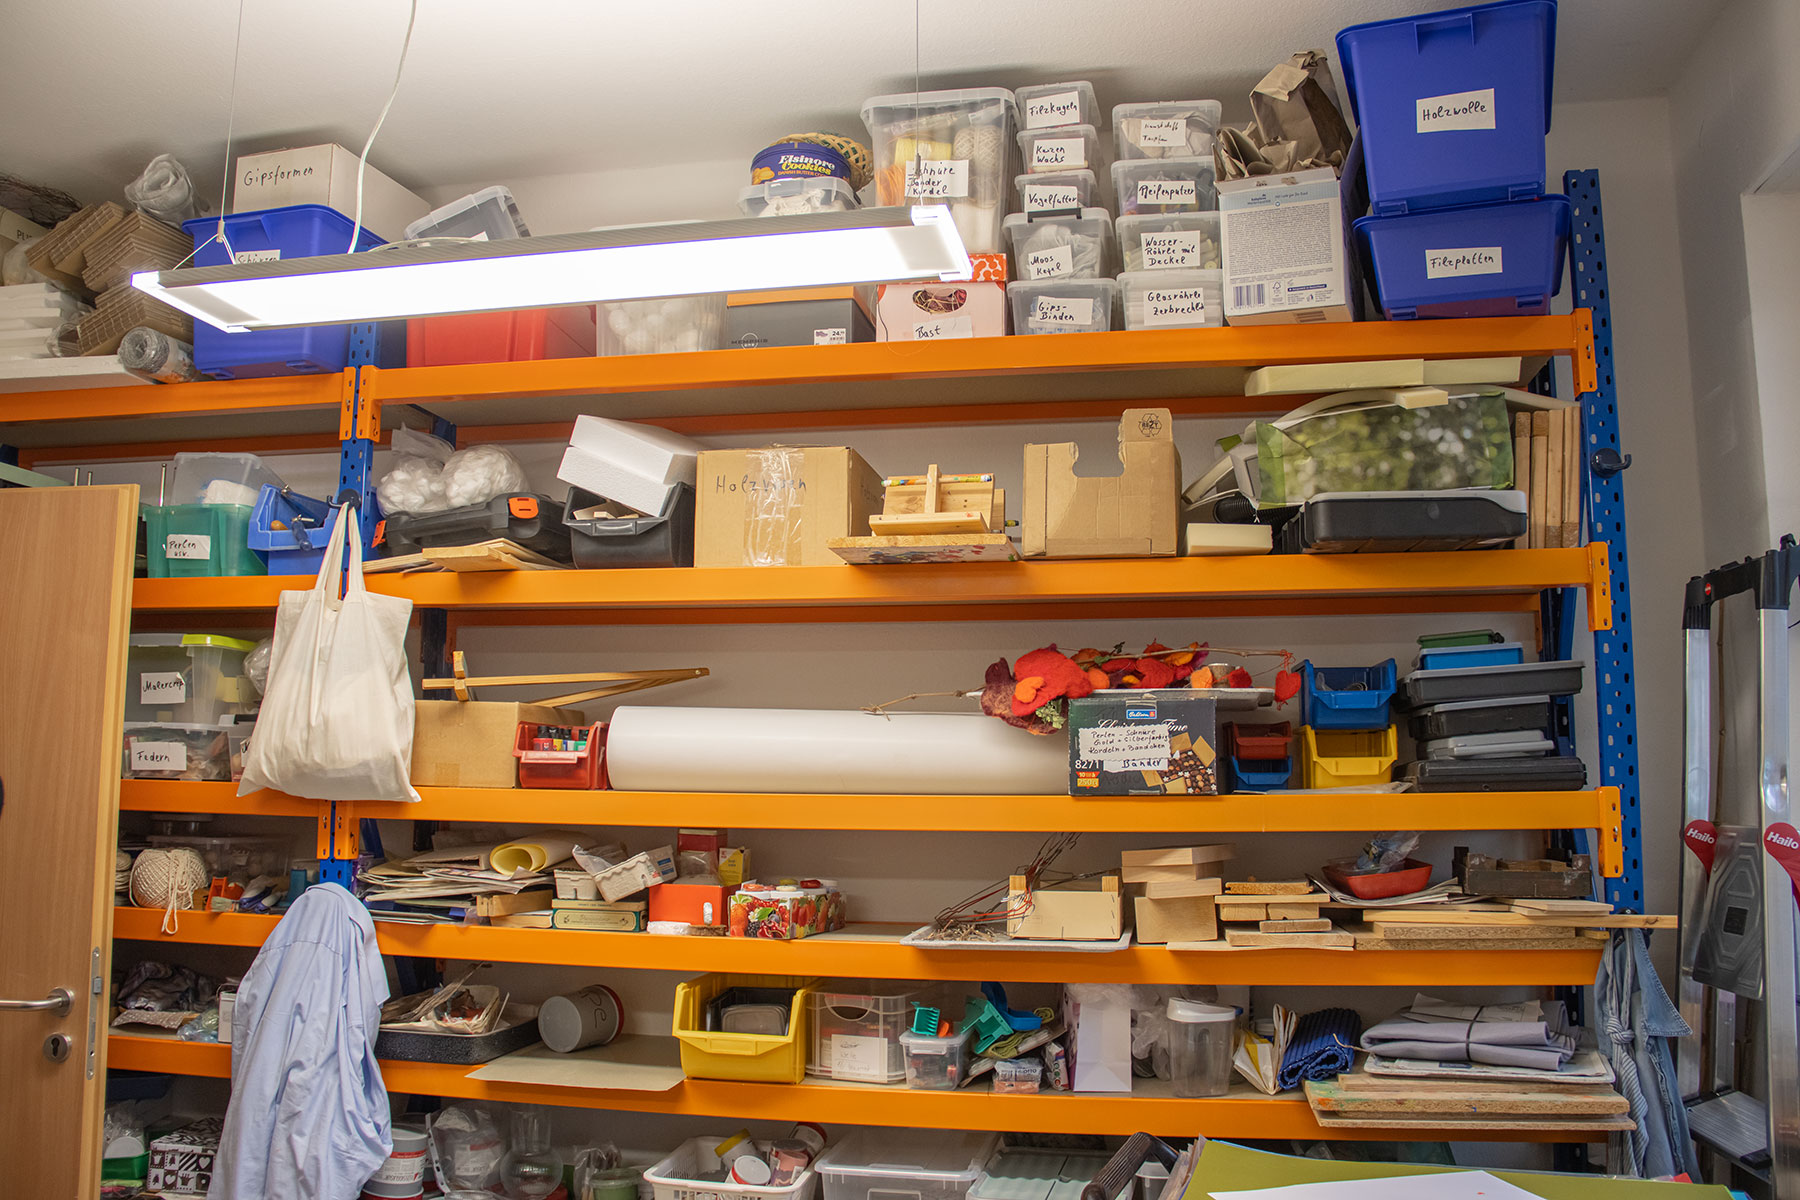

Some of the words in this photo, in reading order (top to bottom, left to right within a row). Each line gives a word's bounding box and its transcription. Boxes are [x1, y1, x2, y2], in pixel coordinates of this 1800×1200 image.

[1422, 100, 1487, 121] Holzwolle
[778, 154, 836, 170] Elsinore
[781, 161, 832, 175] Cookies
[243, 165, 314, 186] Gipsformen
[1030, 255, 1054, 265] Moos
[1148, 256, 1185, 266] Deckel
[1430, 252, 1494, 270] Filzplatten
[1040, 312, 1074, 321] Binden
[915, 325, 941, 340] Bast
[136, 750, 170, 763] Federn
[1686, 828, 1715, 844] Hailo
[1766, 832, 1799, 849] Hailo
